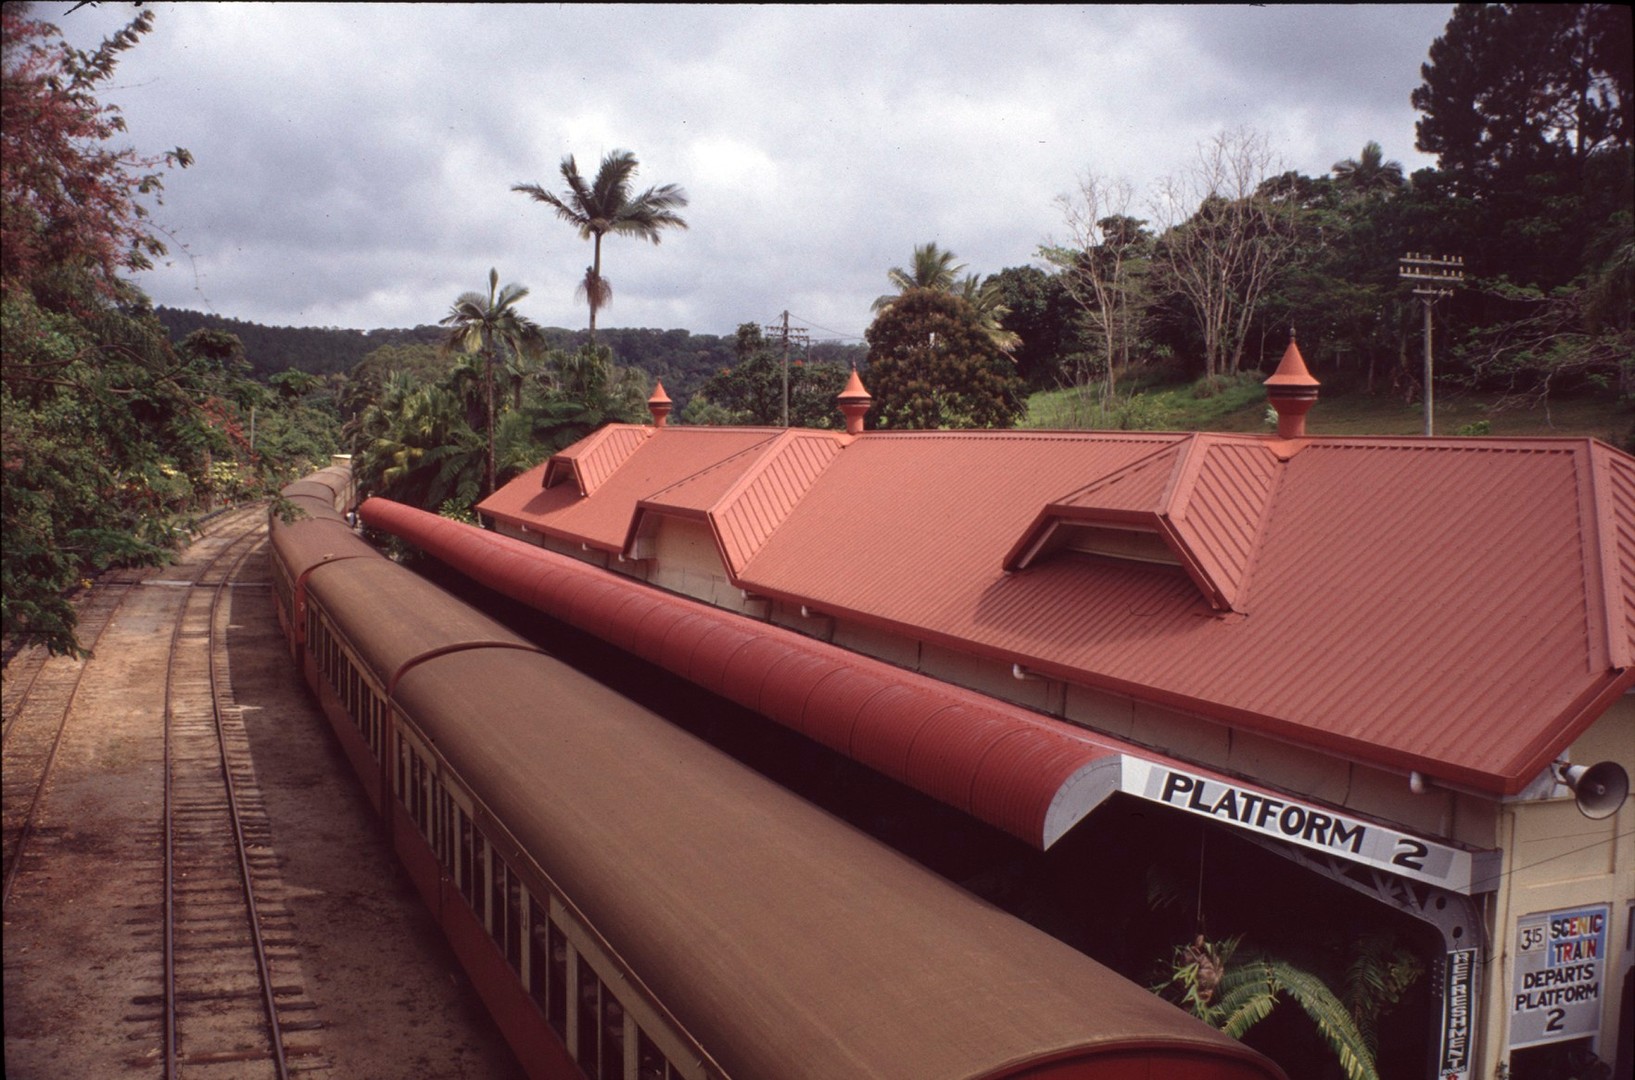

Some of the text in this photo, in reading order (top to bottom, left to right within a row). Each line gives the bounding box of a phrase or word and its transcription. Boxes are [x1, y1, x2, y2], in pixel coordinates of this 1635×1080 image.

[1161, 772, 1428, 870] PLATFORM 2
[1551, 915, 1602, 939] SCENIC
[1555, 939, 1597, 963] TRAIN
[1523, 963, 1594, 990] DEPARTS
[1447, 952, 1469, 1067] REFRESHMENT
[1515, 983, 1598, 1010] PLATFORM
[1546, 1008, 1566, 1031] 2
